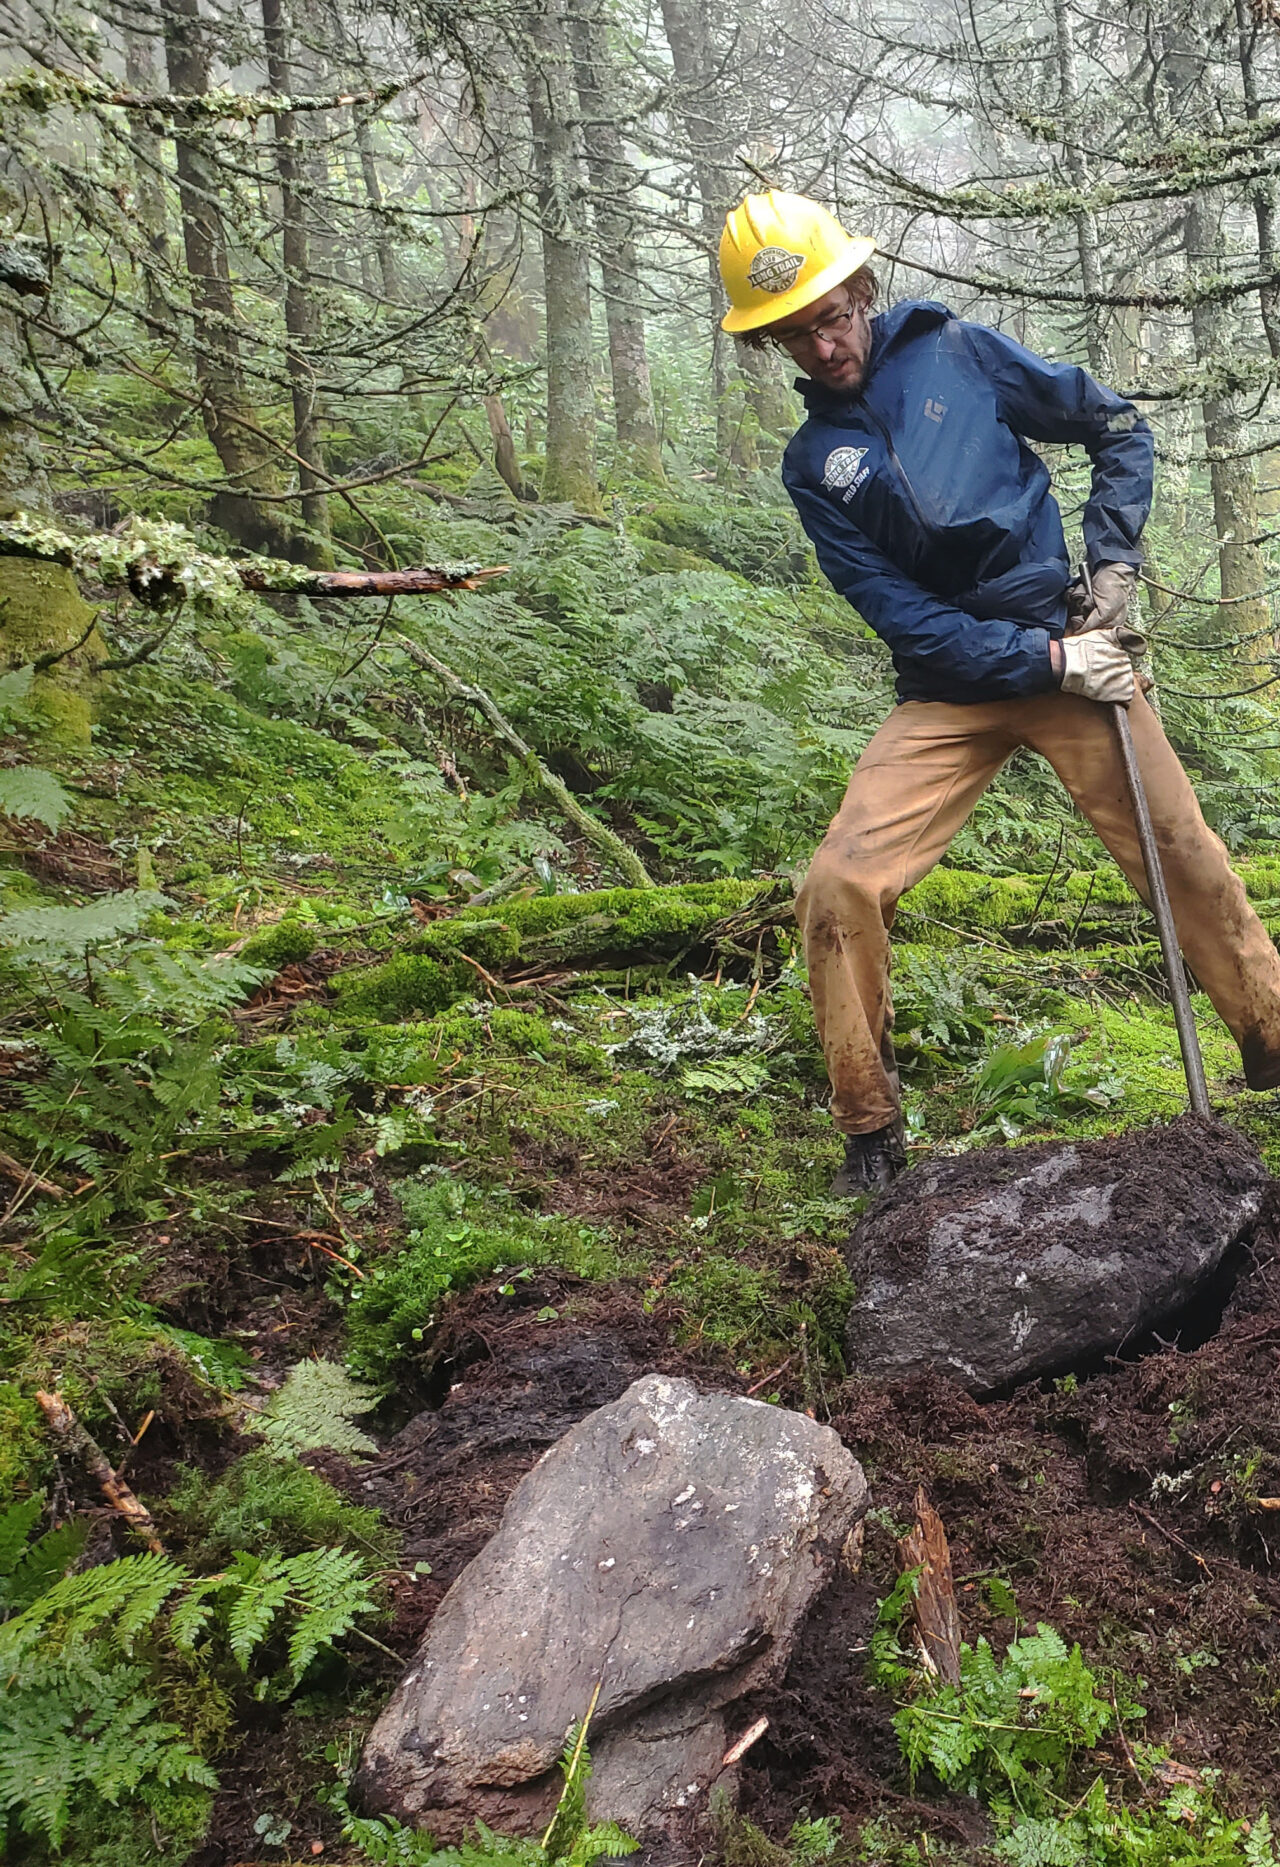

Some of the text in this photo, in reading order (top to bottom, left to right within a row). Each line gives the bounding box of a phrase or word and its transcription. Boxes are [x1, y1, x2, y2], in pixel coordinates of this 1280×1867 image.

[751, 268, 774, 286] LONG
[772, 257, 801, 274] TRAIL
[825, 466, 843, 486] LONG
[841, 451, 864, 467] TRAIL
[842, 485, 857, 504] FIELD
[853, 466, 871, 488] STAFF
